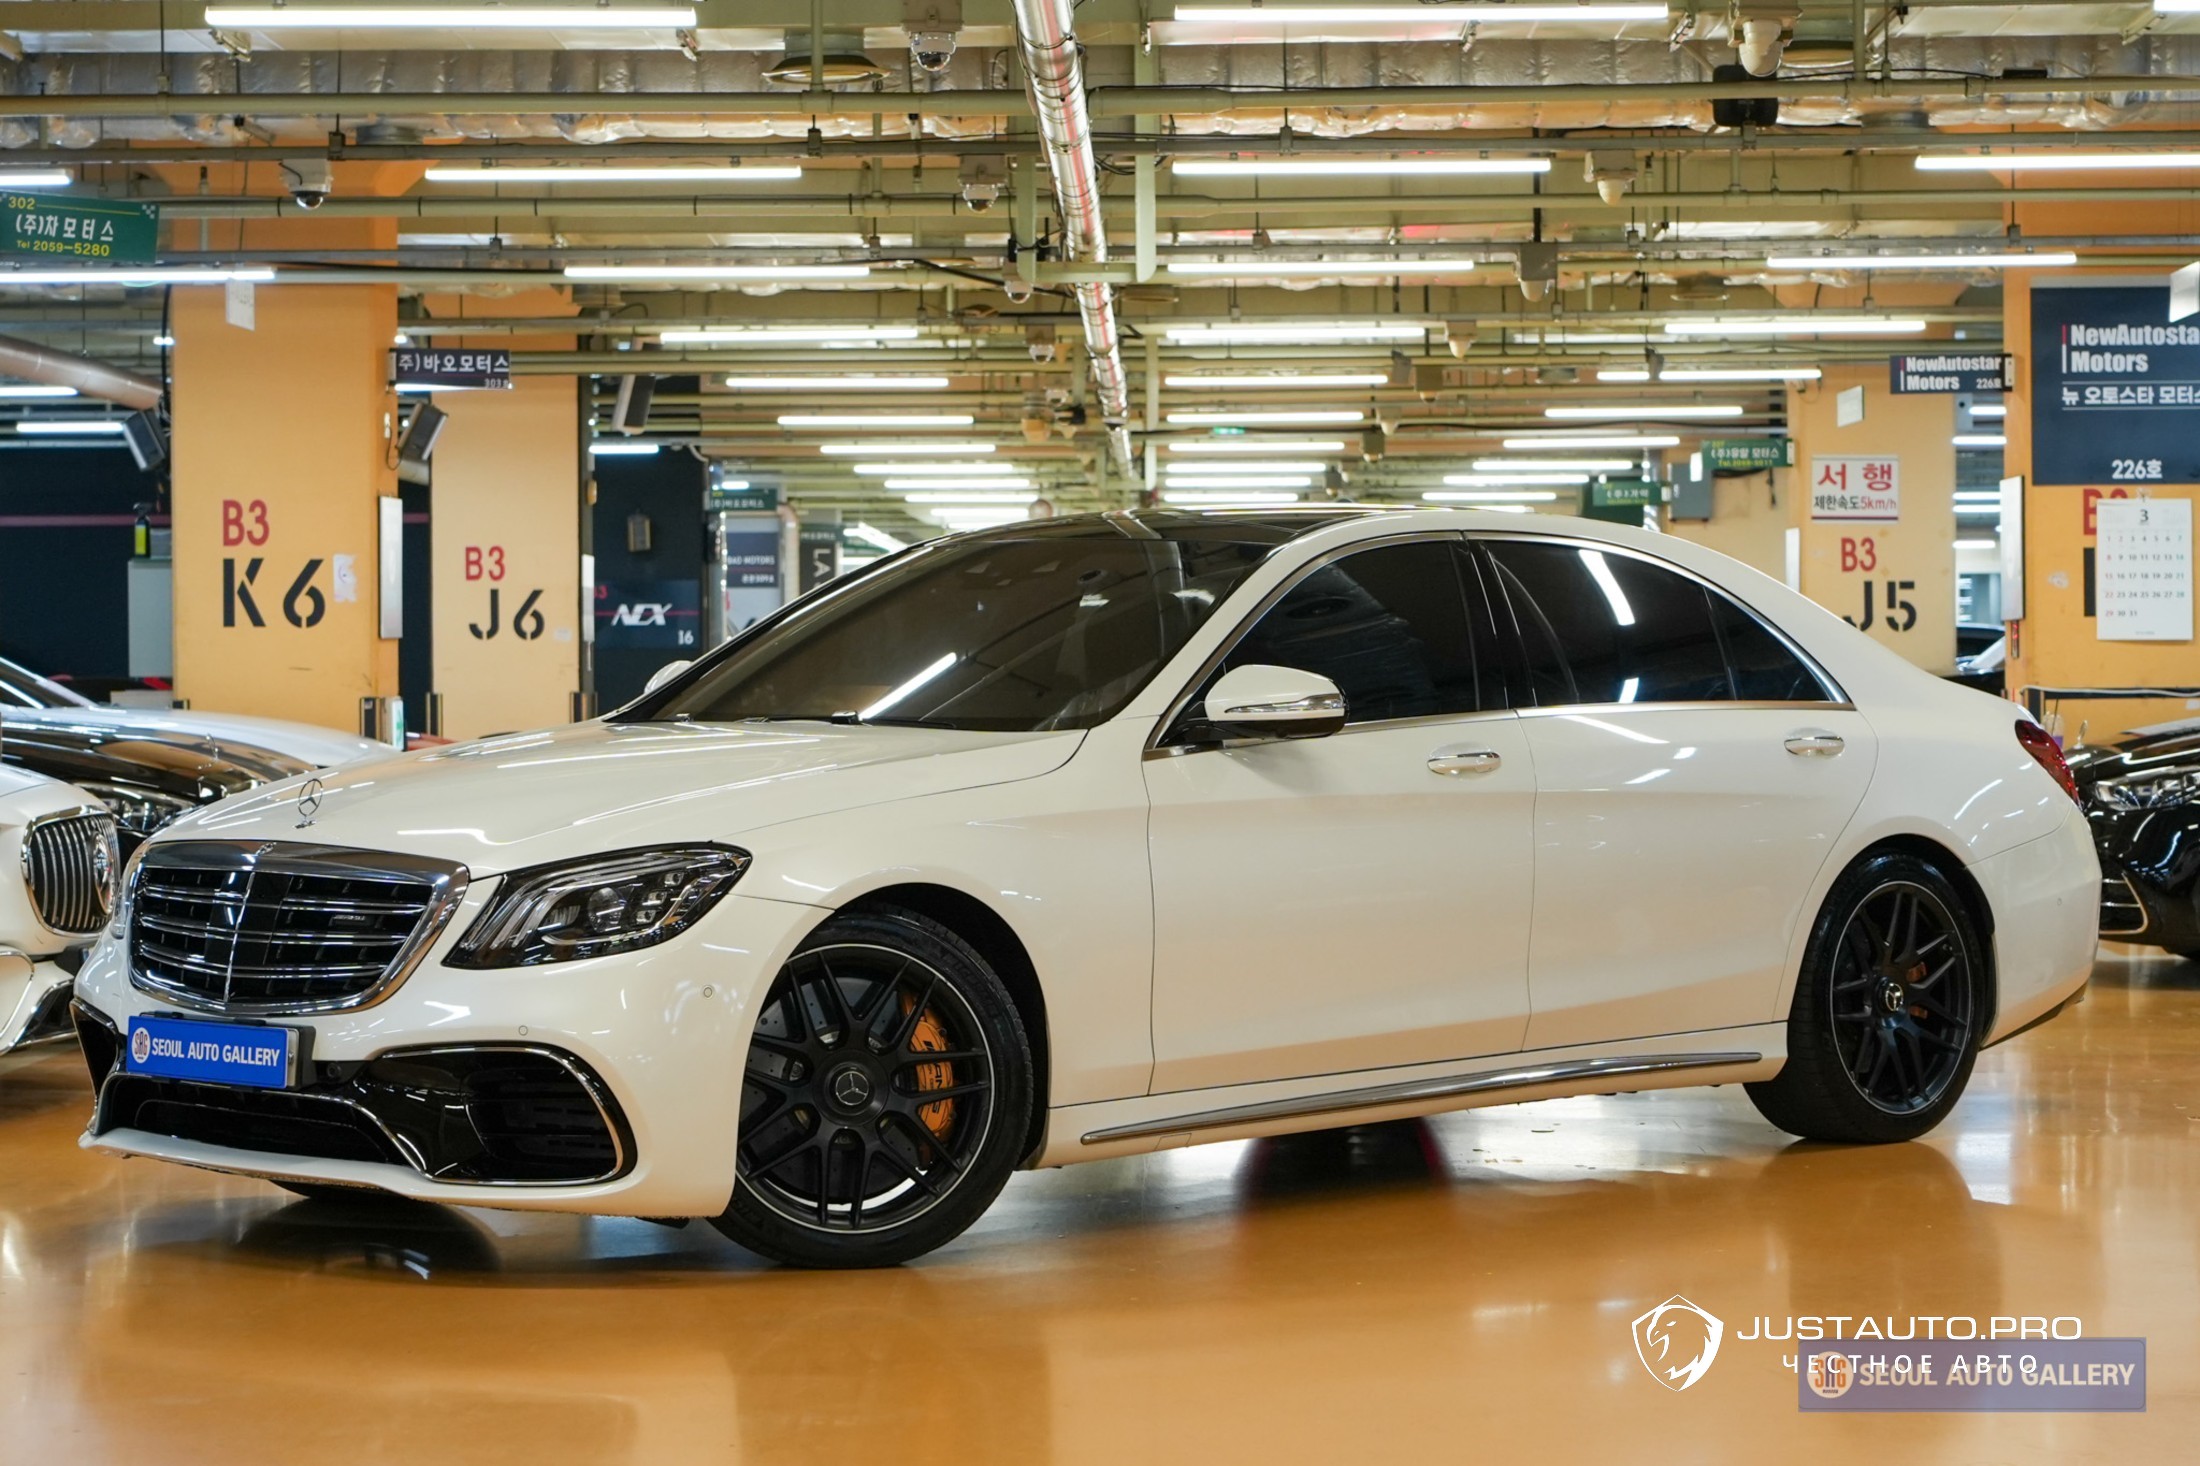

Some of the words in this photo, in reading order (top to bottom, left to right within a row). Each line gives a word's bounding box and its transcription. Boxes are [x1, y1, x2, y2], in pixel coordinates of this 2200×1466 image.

[8, 196, 36, 210] 302
[17, 240, 30, 249] Tel
[33, 240, 110, 257] 2059-5280
[1906, 356, 2002, 372] NewAutostar
[2071, 350, 2149, 373] Motors
[1906, 375, 1960, 390] Motors
[2062, 387, 2079, 405] 뉴
[2084, 386, 2155, 405] 오토스타
[1817, 463, 1847, 490] 서
[1862, 463, 1892, 491] 행
[2112, 458, 2163, 480] 226호
[222, 499, 270, 547] B3
[2140, 508, 2149, 522] 3
[465, 546, 505, 581] B3
[1841, 537, 1877, 572] B3
[611, 604, 673, 626] NEX
[678, 630, 694, 645] 16
[152, 1037, 185, 1059] SEOUL
[187, 1041, 220, 1062] AUTO
[222, 1046, 281, 1068] GALLERY
